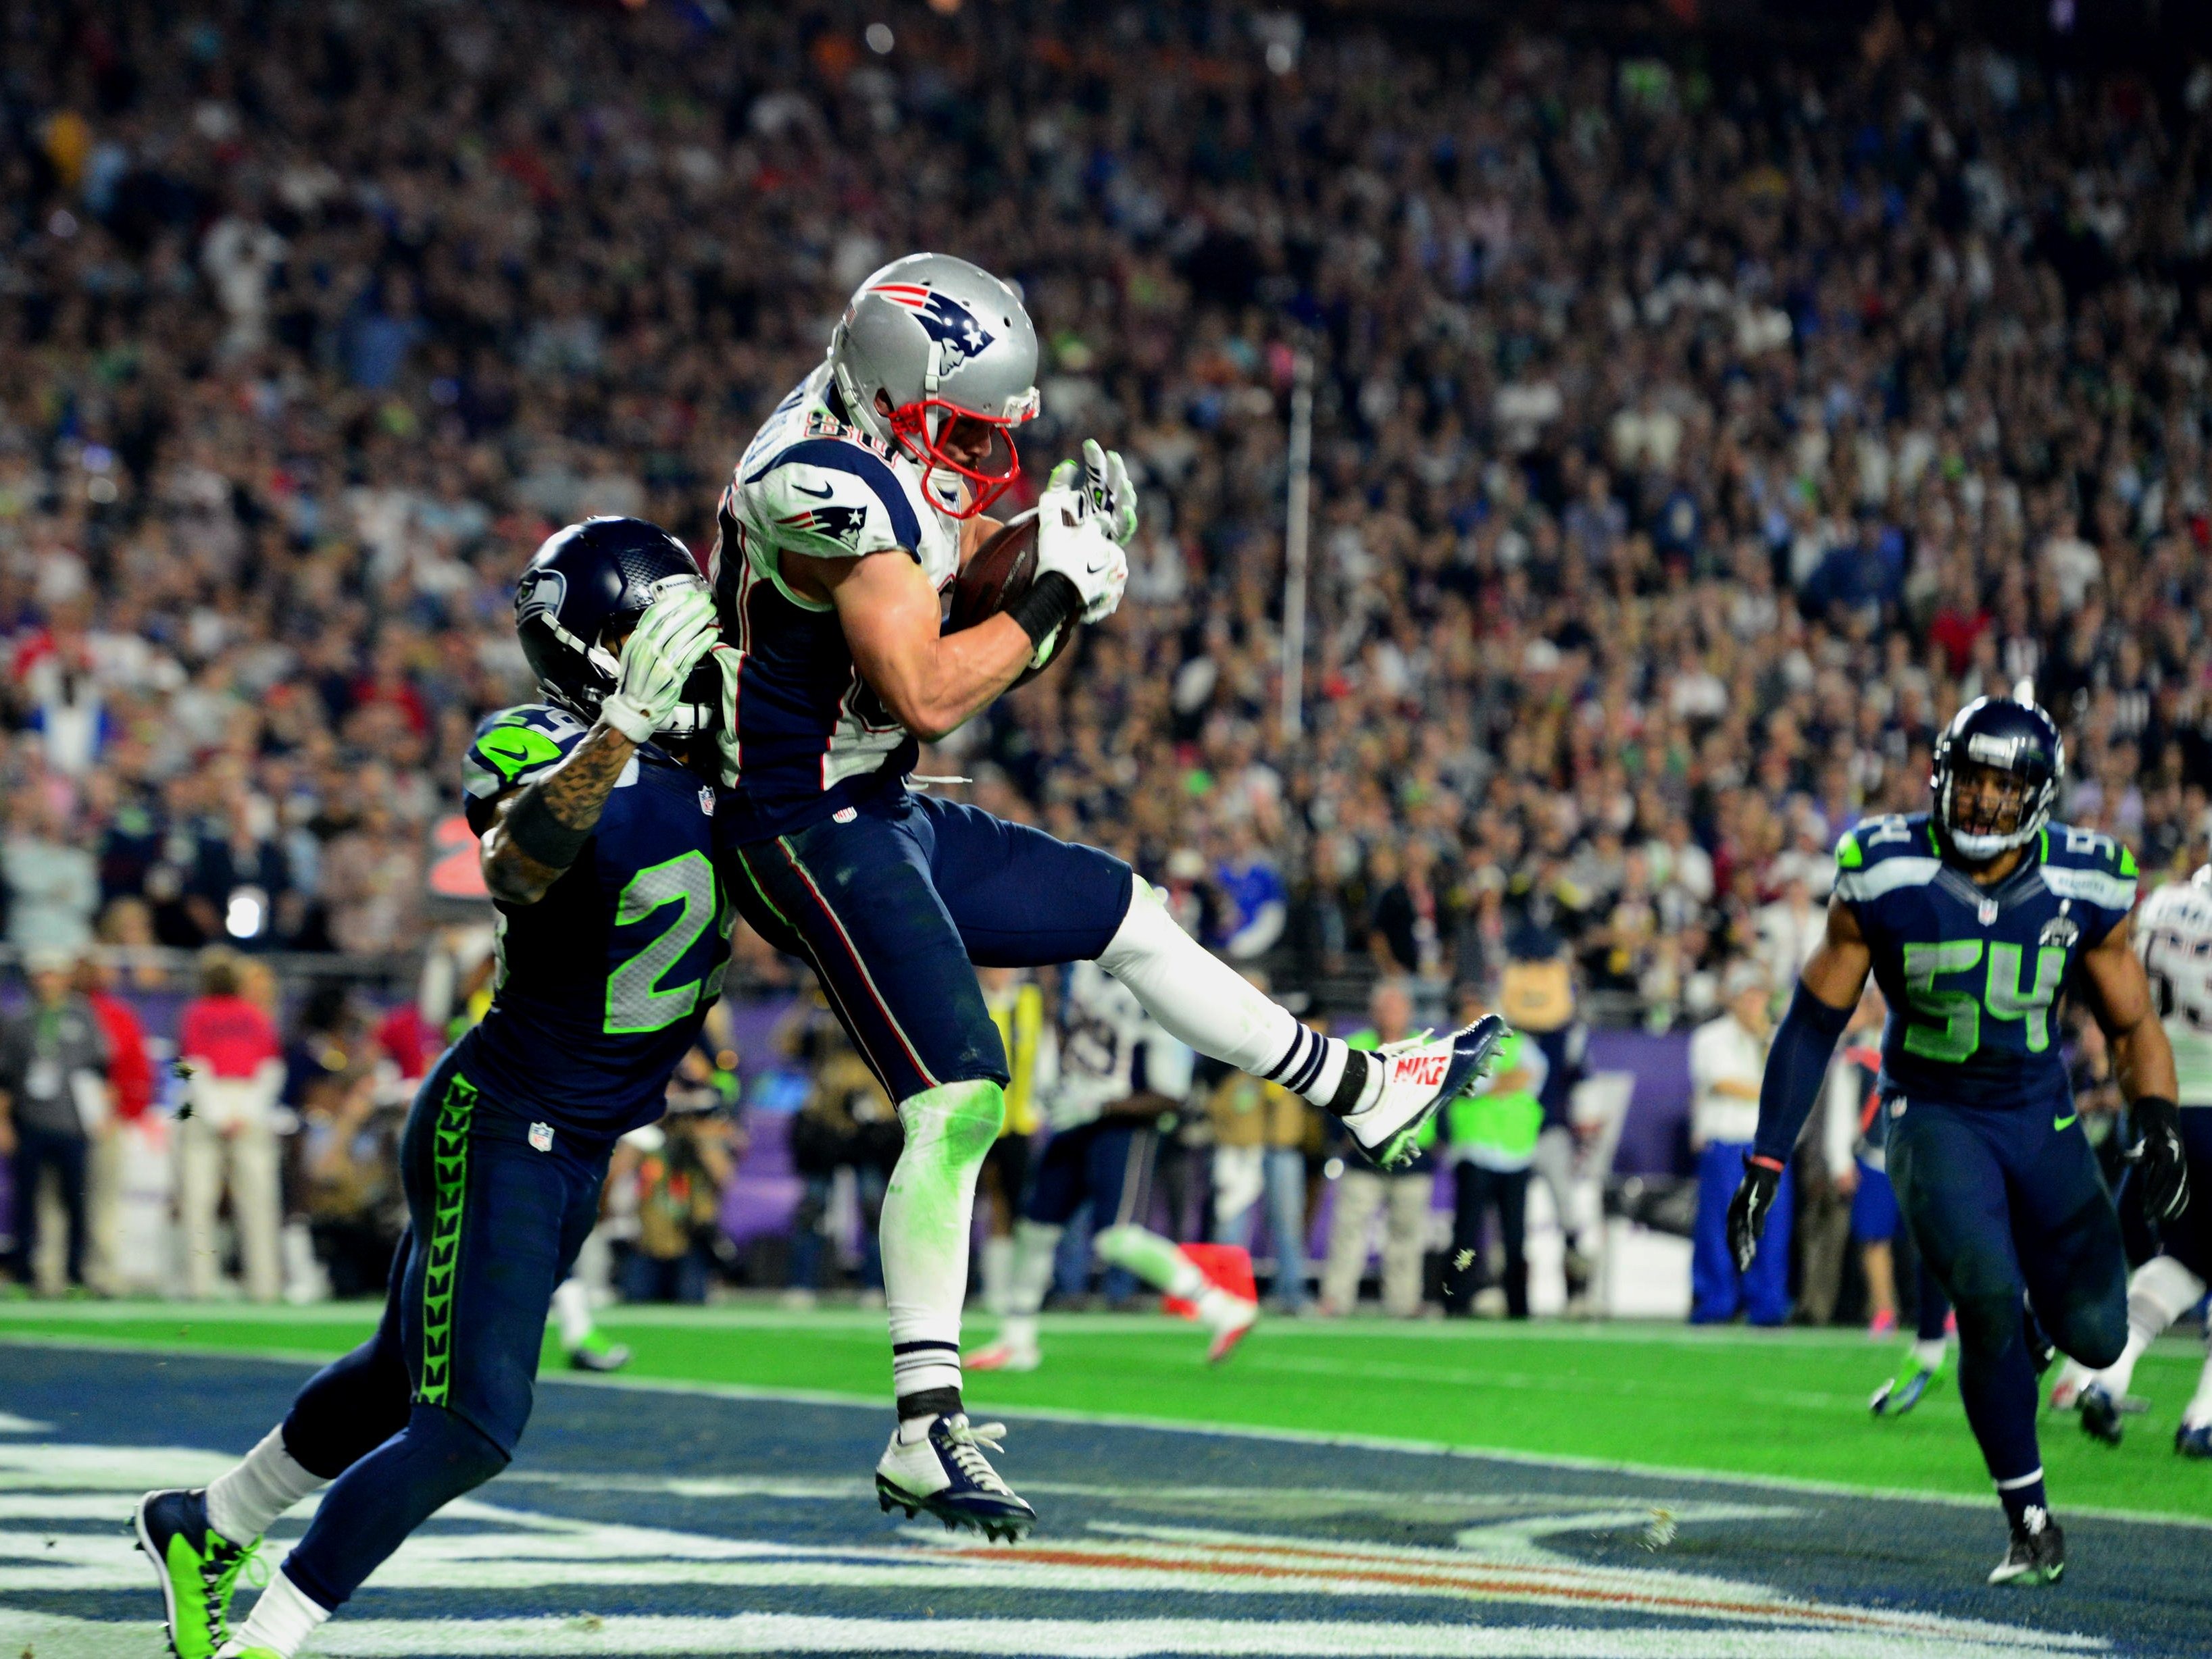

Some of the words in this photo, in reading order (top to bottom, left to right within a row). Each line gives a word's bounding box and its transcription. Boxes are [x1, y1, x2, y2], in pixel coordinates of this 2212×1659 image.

[603, 849, 735, 1033] 2
[1903, 939, 2066, 1063] 54
[1392, 1056, 1449, 1086] NIKE
